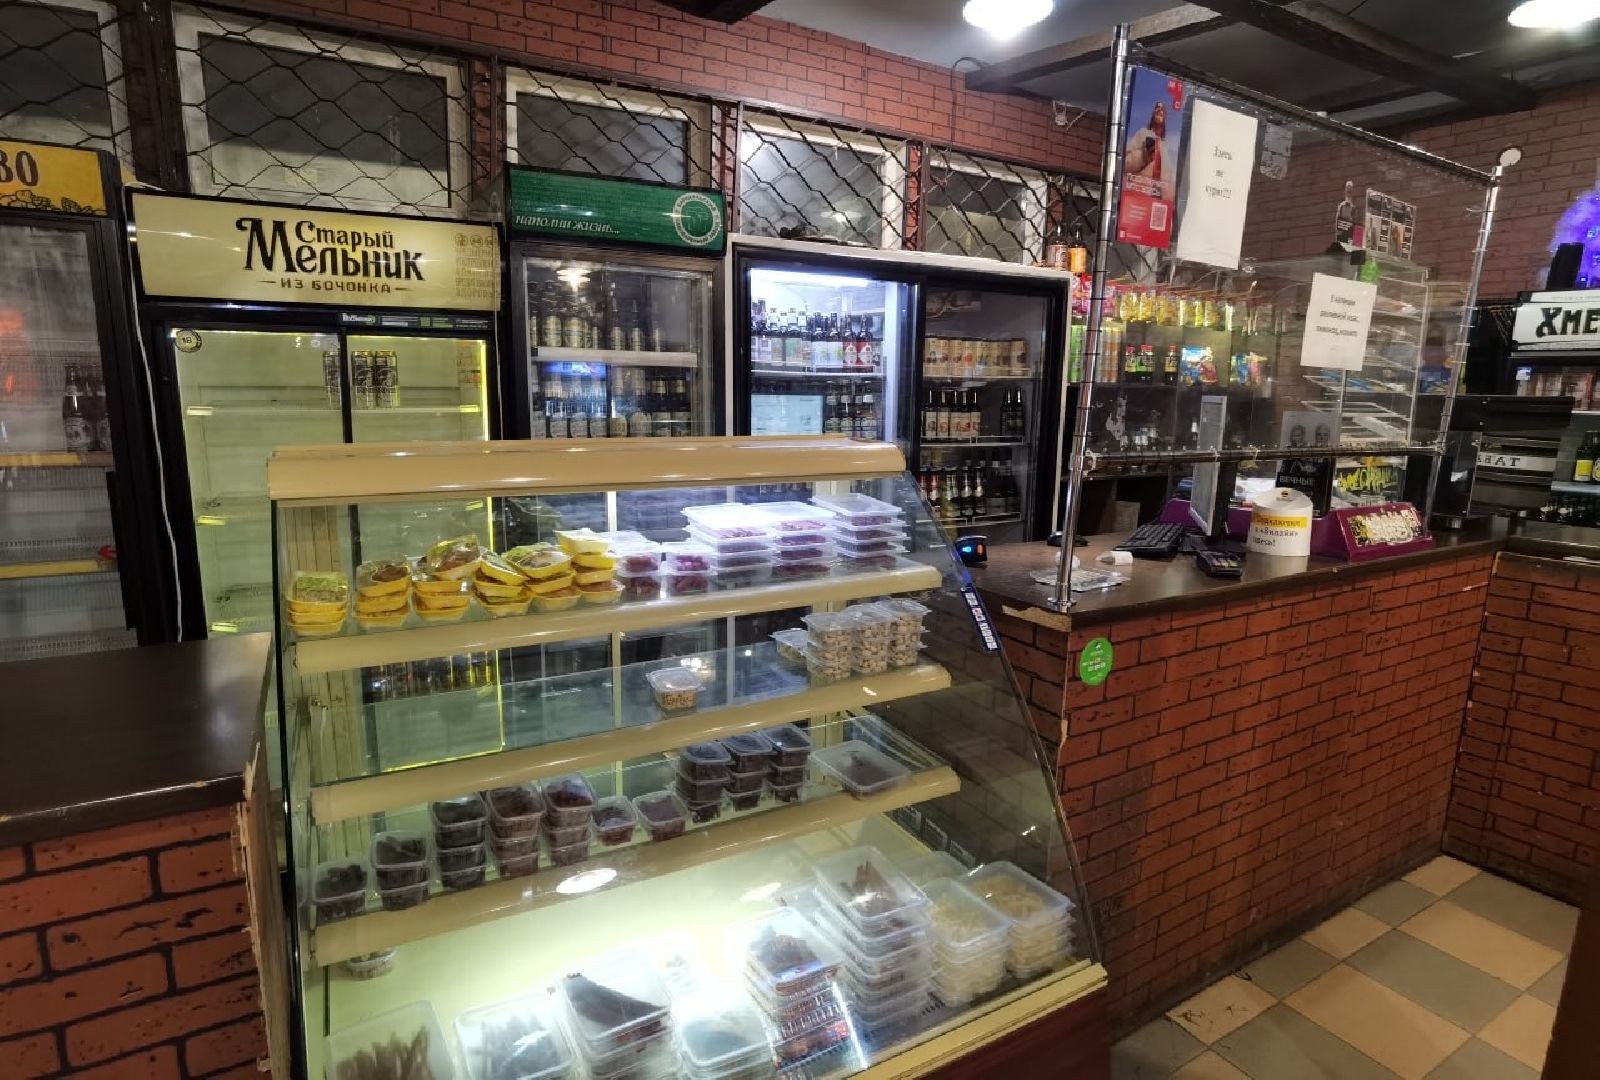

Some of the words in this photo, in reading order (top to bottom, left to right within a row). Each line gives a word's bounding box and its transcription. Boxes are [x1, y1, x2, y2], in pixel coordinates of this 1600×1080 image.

[235, 217, 425, 281] Мельник
[295, 220, 394, 253] Старый
[281, 277, 304, 289] ИЗ
[311, 280, 391, 293] БОЧОНКА
